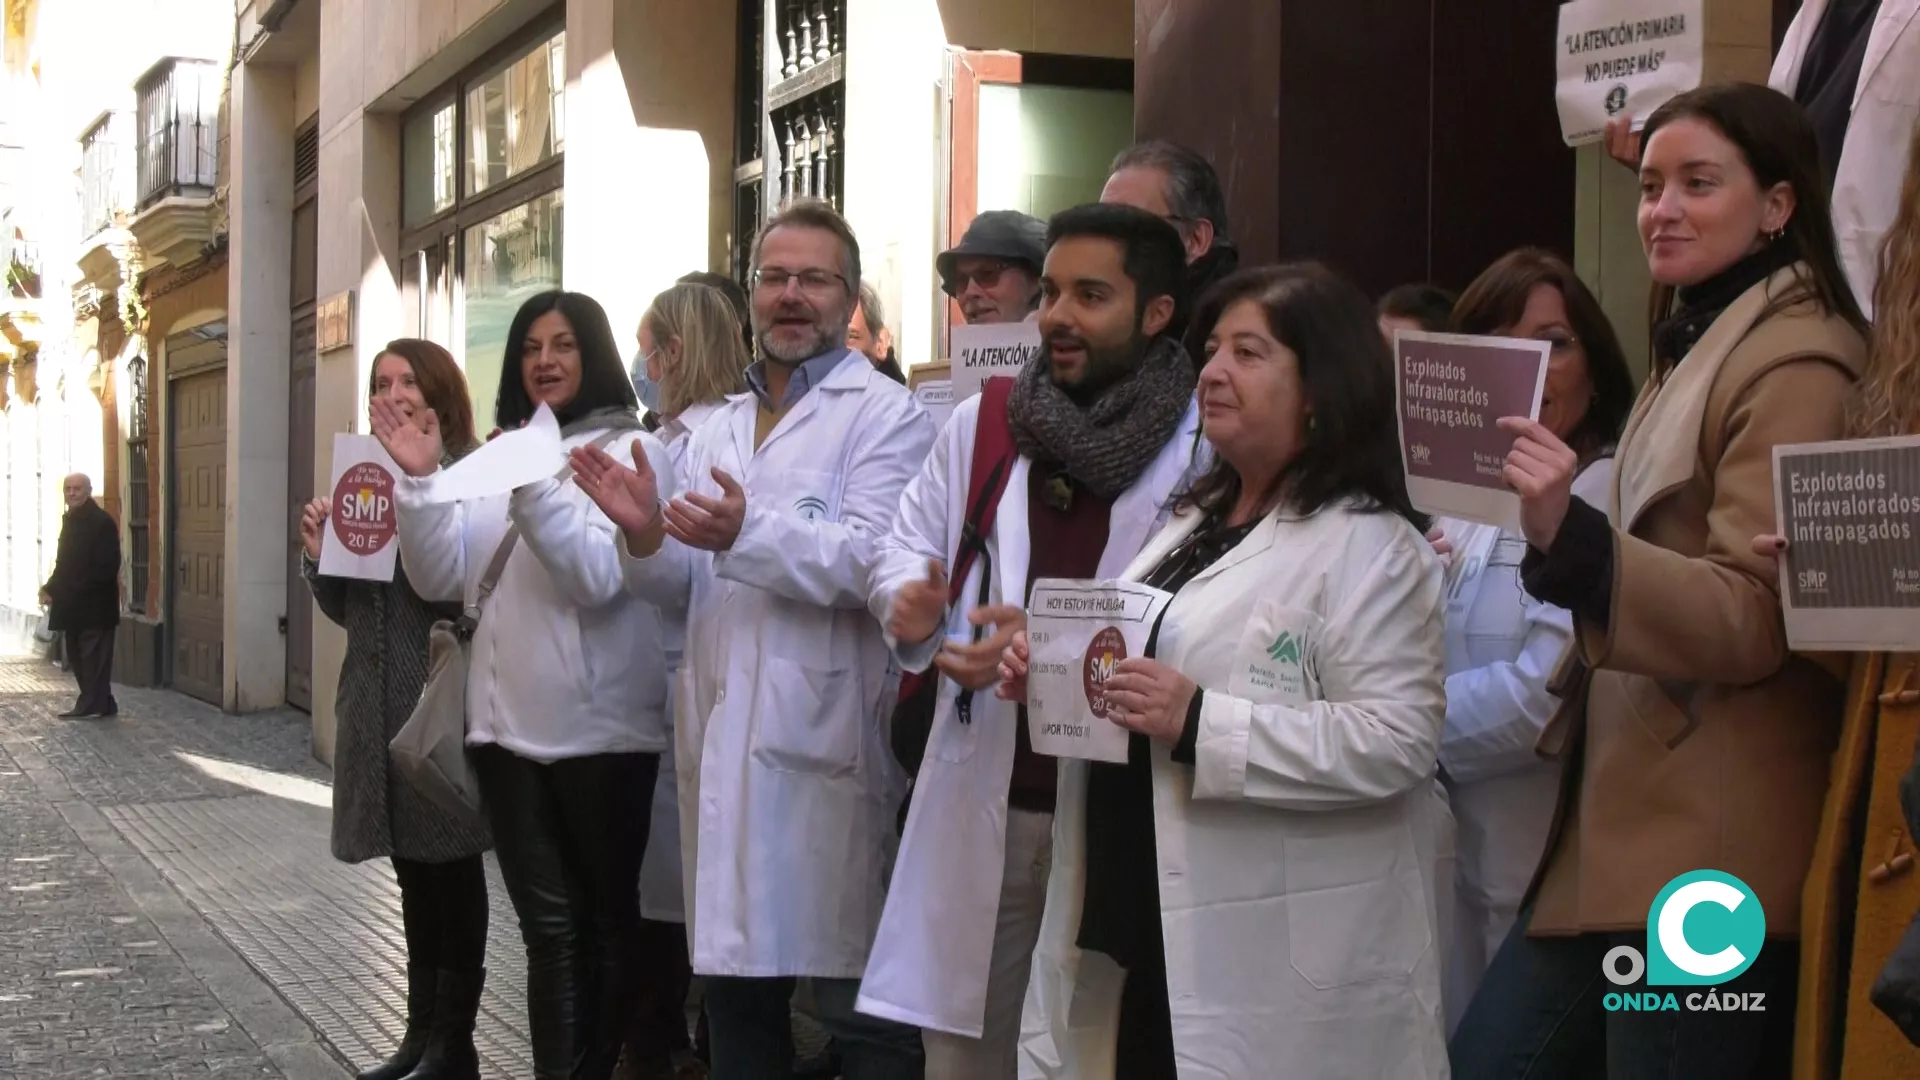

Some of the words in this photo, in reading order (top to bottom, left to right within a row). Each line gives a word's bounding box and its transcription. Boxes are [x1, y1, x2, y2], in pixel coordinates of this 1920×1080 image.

[1582, 20, 1634, 51] ATENCIÓN
[1636, 14, 1686, 43] PRIMARIA
[1584, 62, 1601, 83] NO
[1602, 56, 1636, 79] PUEDE
[978, 342, 1029, 367] ATENCIÓN
[1405, 356, 1466, 381] Explotados
[1405, 378, 1489, 407] Infravalorados
[1406, 400, 1484, 428] Infrapagados
[1411, 444, 1431, 461] SMP
[1790, 469, 1886, 497] Explotados
[342, 493, 389, 521] SMP
[1792, 493, 1920, 517] Infravalorados
[348, 532, 364, 548] 20
[368, 534, 379, 550] E
[1794, 518, 1911, 544] Infrapagados
[1798, 570, 1828, 588] SMP
[1046, 597, 1062, 610] HOY
[1063, 598, 1087, 611] ESTOY
[1092, 695, 1104, 711] 20
